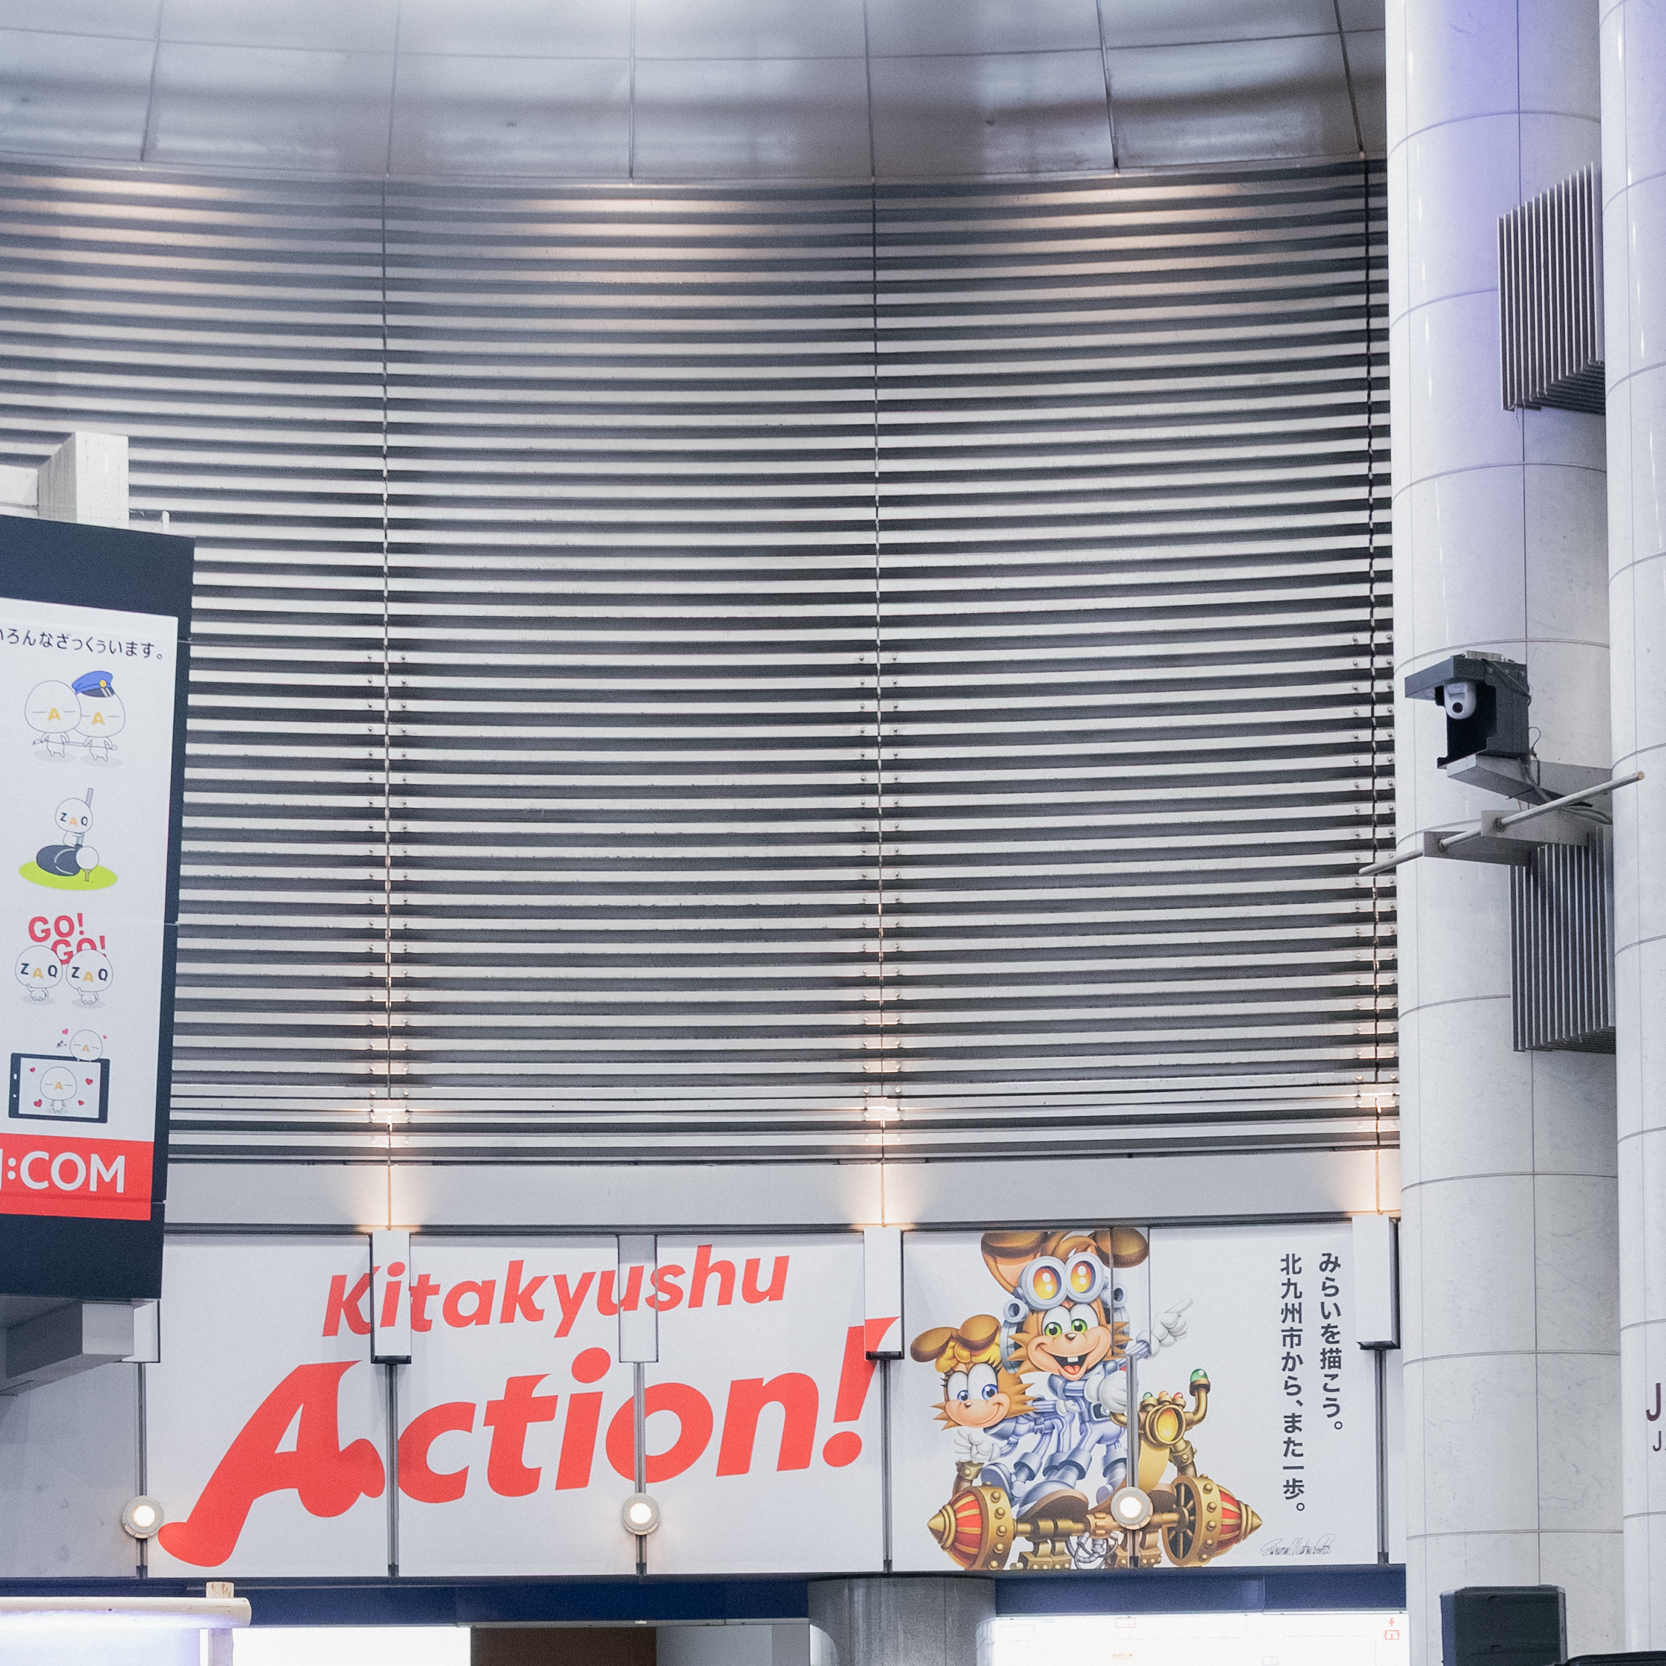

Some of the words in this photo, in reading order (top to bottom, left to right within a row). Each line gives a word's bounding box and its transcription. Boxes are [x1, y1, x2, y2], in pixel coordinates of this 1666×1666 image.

[28, 912, 84, 943] GO!
[322, 1245, 790, 1338] Kitakyushu
[1318, 1251, 1343, 1432] みらいを描こう。
[158, 1315, 901, 1568] Action!
[1279, 1253, 1306, 1514] 北九州市から、また一歩。
